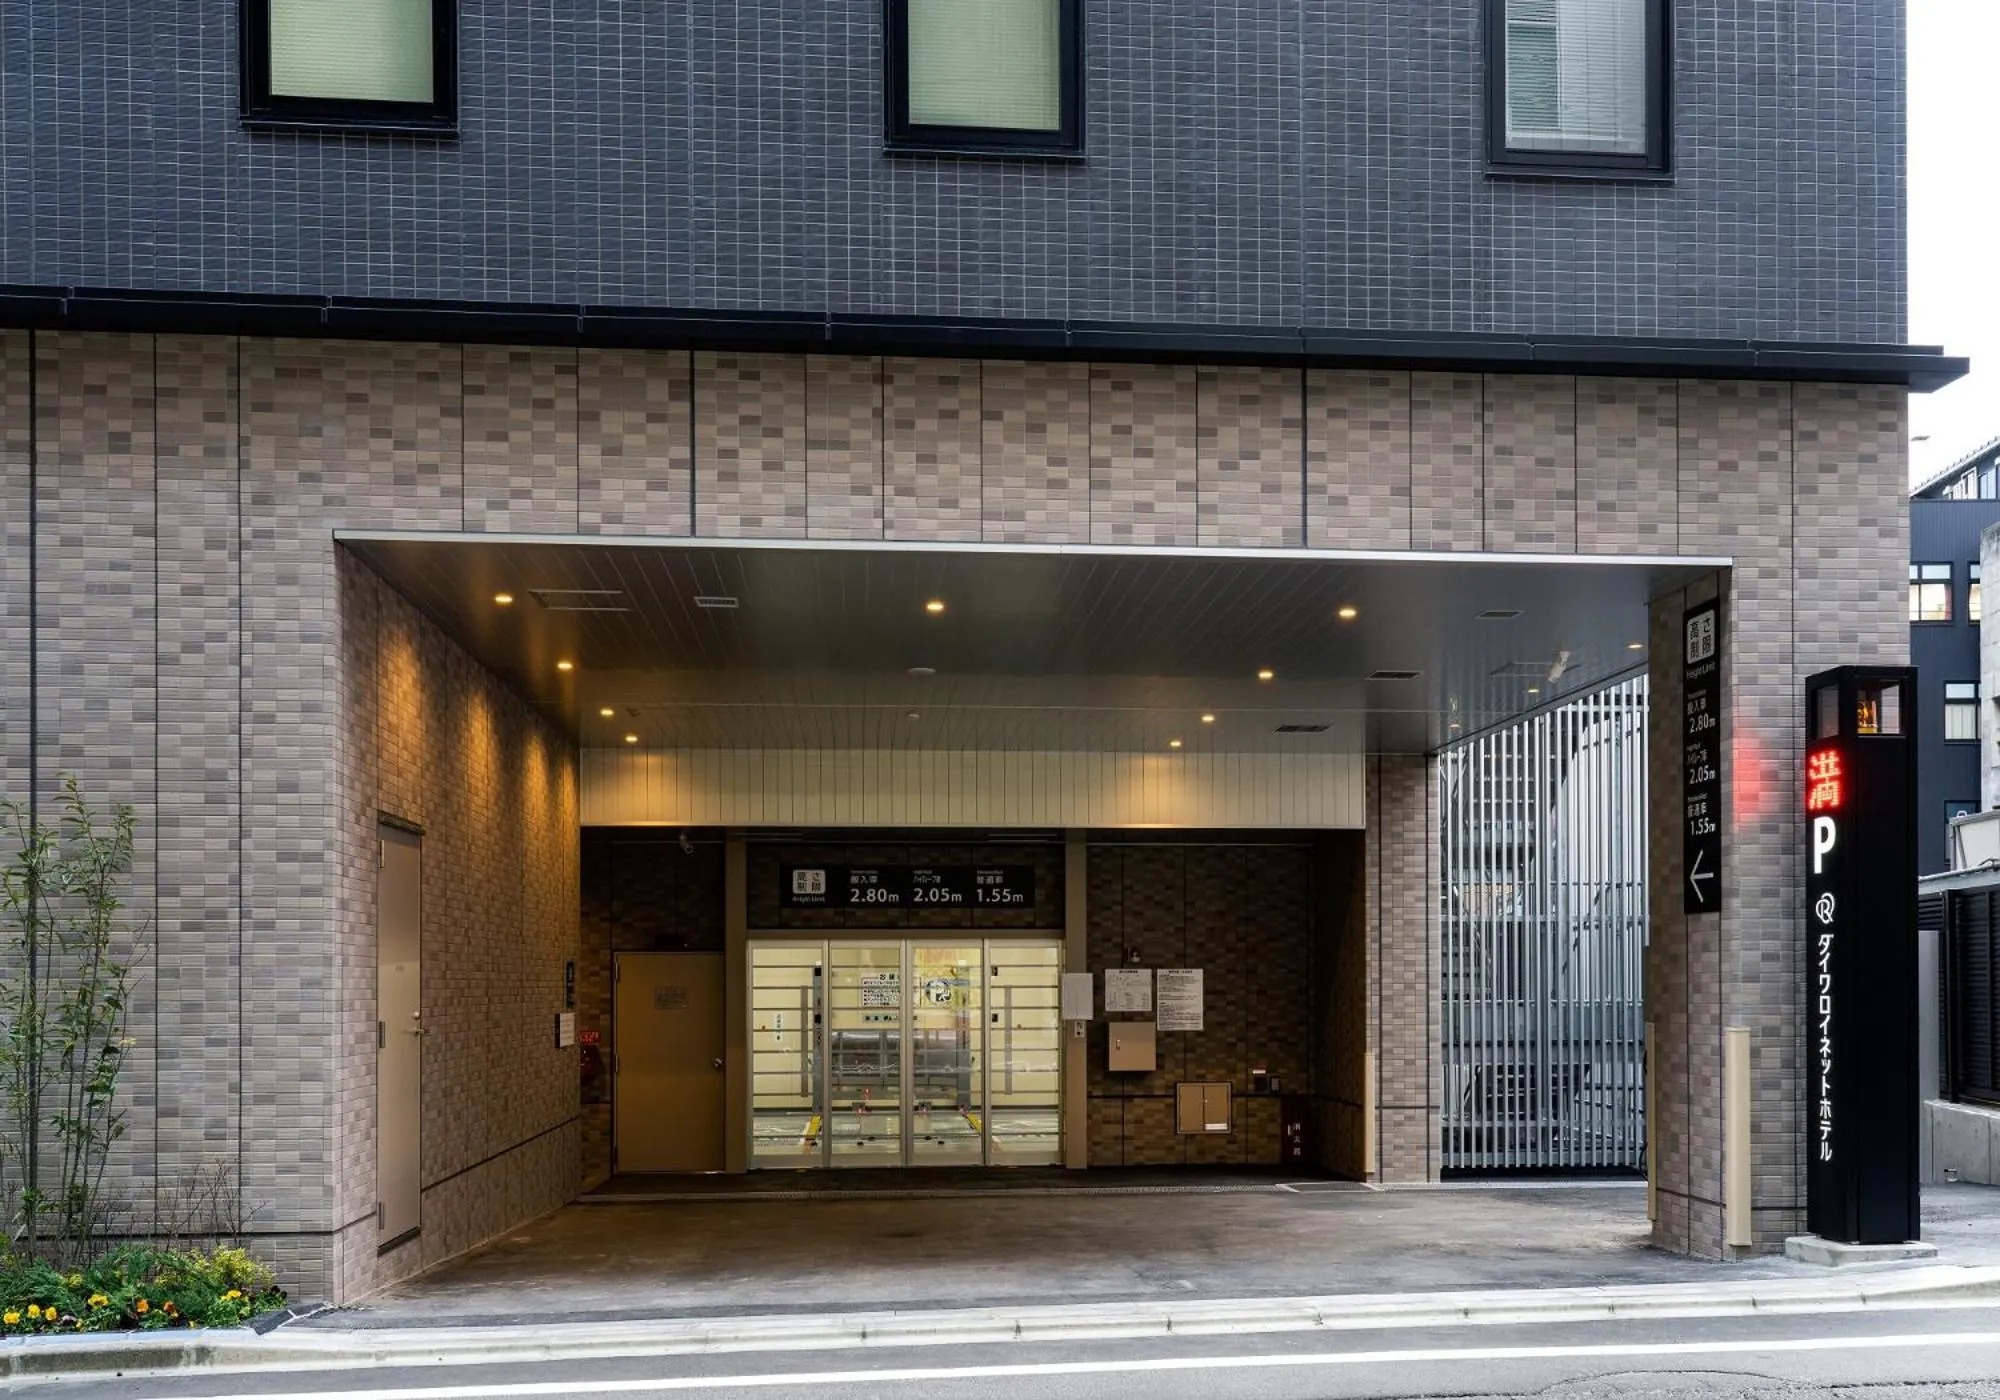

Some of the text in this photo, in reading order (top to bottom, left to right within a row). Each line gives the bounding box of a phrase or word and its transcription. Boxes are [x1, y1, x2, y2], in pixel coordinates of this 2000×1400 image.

[1690, 614, 1712, 640] 高さ
[1689, 713, 1716, 733] 2.80m
[1689, 764, 1716, 784] 2.05m
[1690, 817, 1716, 836] 1.55m
[1814, 816, 1836, 874] P
[850, 888, 899, 902] 2.80m
[913, 888, 962, 902] 2.05m
[976, 888, 1023, 902] 1.55m
[1818, 933, 1834, 1162] ダイワロイネットホテル
